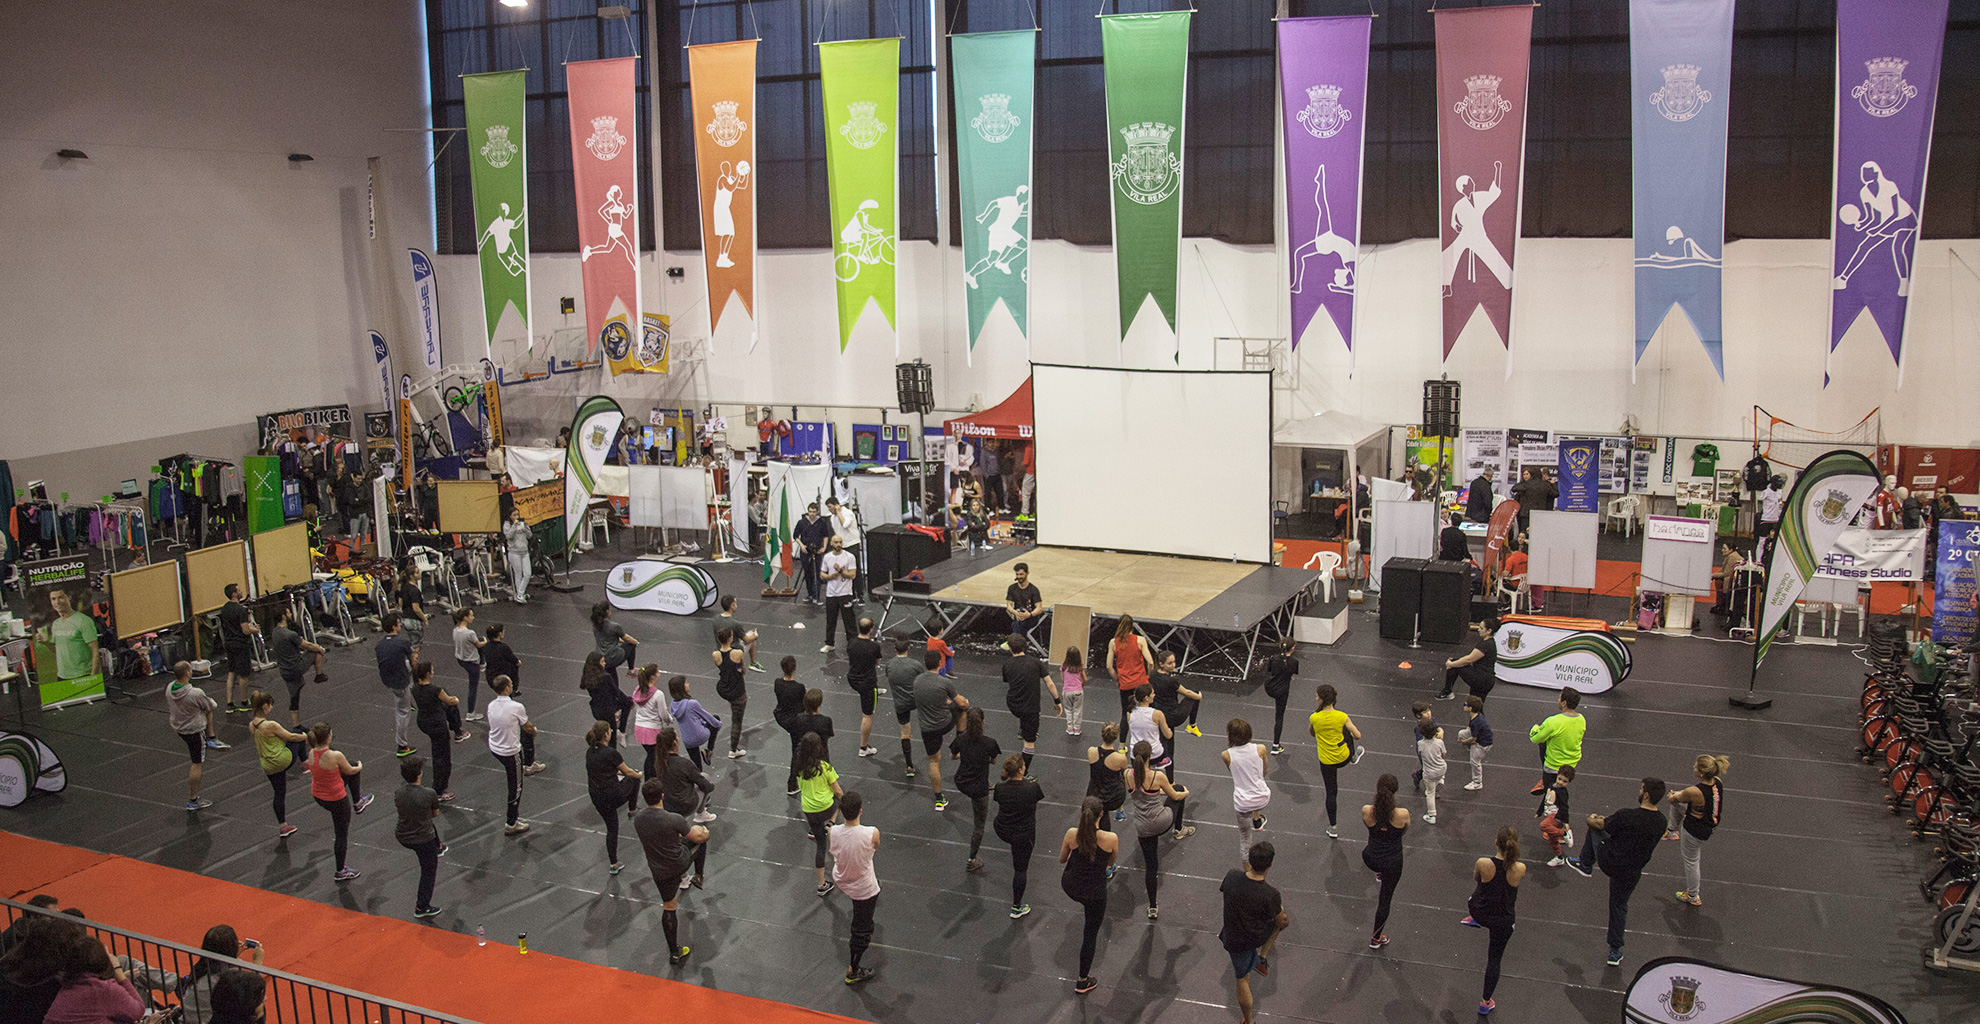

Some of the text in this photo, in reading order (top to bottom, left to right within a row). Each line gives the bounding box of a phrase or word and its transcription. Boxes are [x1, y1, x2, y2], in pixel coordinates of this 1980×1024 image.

[1130, 191, 1168, 202] VILA REAL
[278, 408, 351, 430] BILABIKER
[950, 422, 997, 436] Wilson
[28, 562, 84, 576] NUTRIÇÃO
[30, 568, 85, 582] HERBALIFE
[1818, 564, 1912, 578] Fitness Studio
[1554, 663, 1598, 677] MUNÍCIPIO
[1556, 672, 1594, 684] VILA REAL
